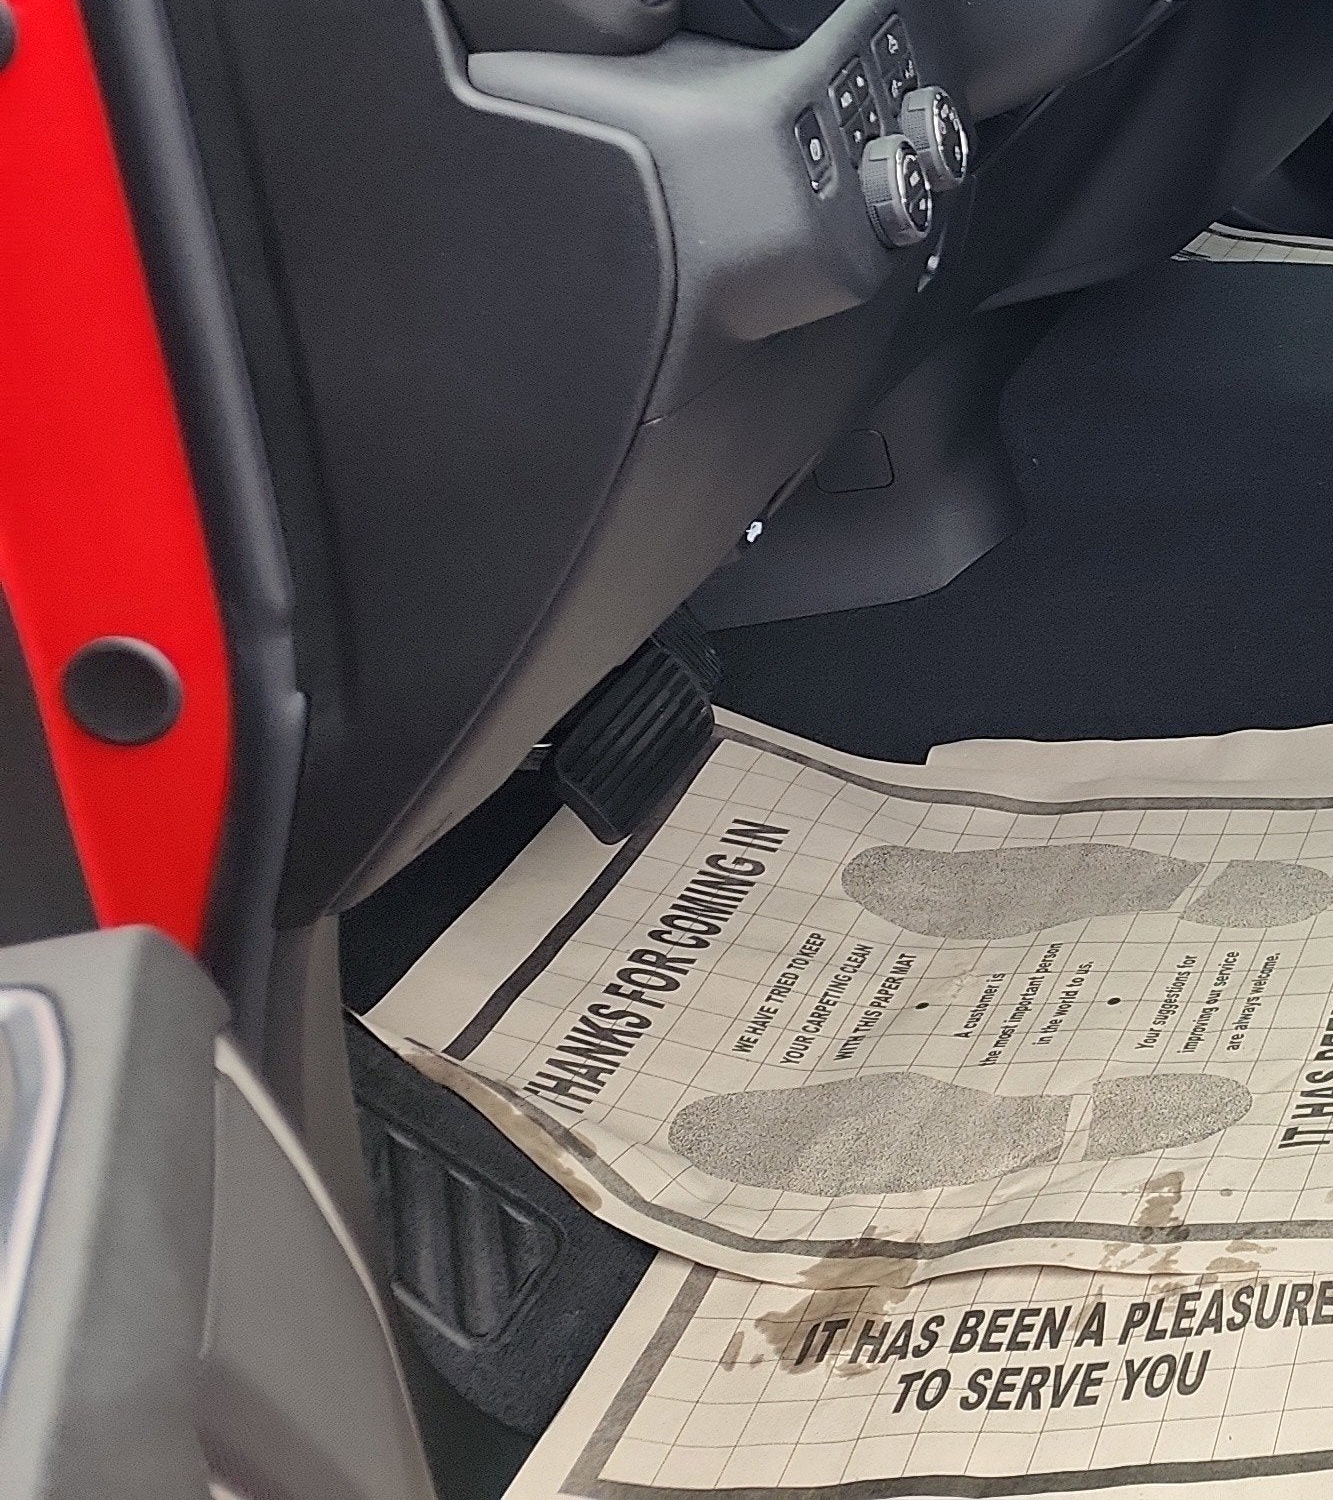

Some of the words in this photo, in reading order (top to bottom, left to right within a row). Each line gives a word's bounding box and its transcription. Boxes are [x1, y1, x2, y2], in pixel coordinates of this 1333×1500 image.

[720, 818, 790, 853] IN
[648, 854, 766, 949] COMING
[1036, 943, 1063, 974] person
[1214, 951, 1240, 987] service
[602, 949, 698, 1009] FOR
[732, 1035, 758, 1053] WE
[748, 1006, 779, 1036] HAVE
[765, 972, 800, 1003] TRIED
[787, 957, 809, 971] TO
[800, 932, 827, 959] KEEP
[1066, 977, 1085, 988] to
[1206, 989, 1223, 1005] our
[779, 1035, 815, 1065] YOUR
[802, 974, 852, 1033] CARPETING
[840, 943, 874, 974] CLEAN
[833, 1034, 866, 1061] WITH
[853, 1009, 882, 1035] THIS
[869, 976, 904, 1009] PAPER
[889, 953, 917, 979] MAT
[964, 984, 999, 1029] customer
[986, 973, 1006, 983] is
[1004, 976, 1045, 1023] important
[1053, 990, 1079, 1018] world
[1134, 1027, 1162, 1049] Your
[1153, 971, 1190, 1026] suggestions
[1177, 955, 1197, 969] for
[1232, 996, 1261, 1030] always
[994, 1024, 1018, 1048] most
[1032, 1036, 1053, 1045] in
[1041, 1019, 1063, 1034] the
[1177, 1006, 1219, 1053] improving
[1227, 1033, 1244, 1051] are
[978, 1050, 1002, 1066] the
[796, 1317, 850, 1367] IT
[849, 1314, 946, 1365] HAS
[949, 1303, 1072, 1354] BEEN
[1076, 1301, 1106, 1348] A
[891, 1368, 951, 1415] TO
[960, 1362, 1110, 1411] SERVE
[1121, 1350, 1212, 1401] YOU
